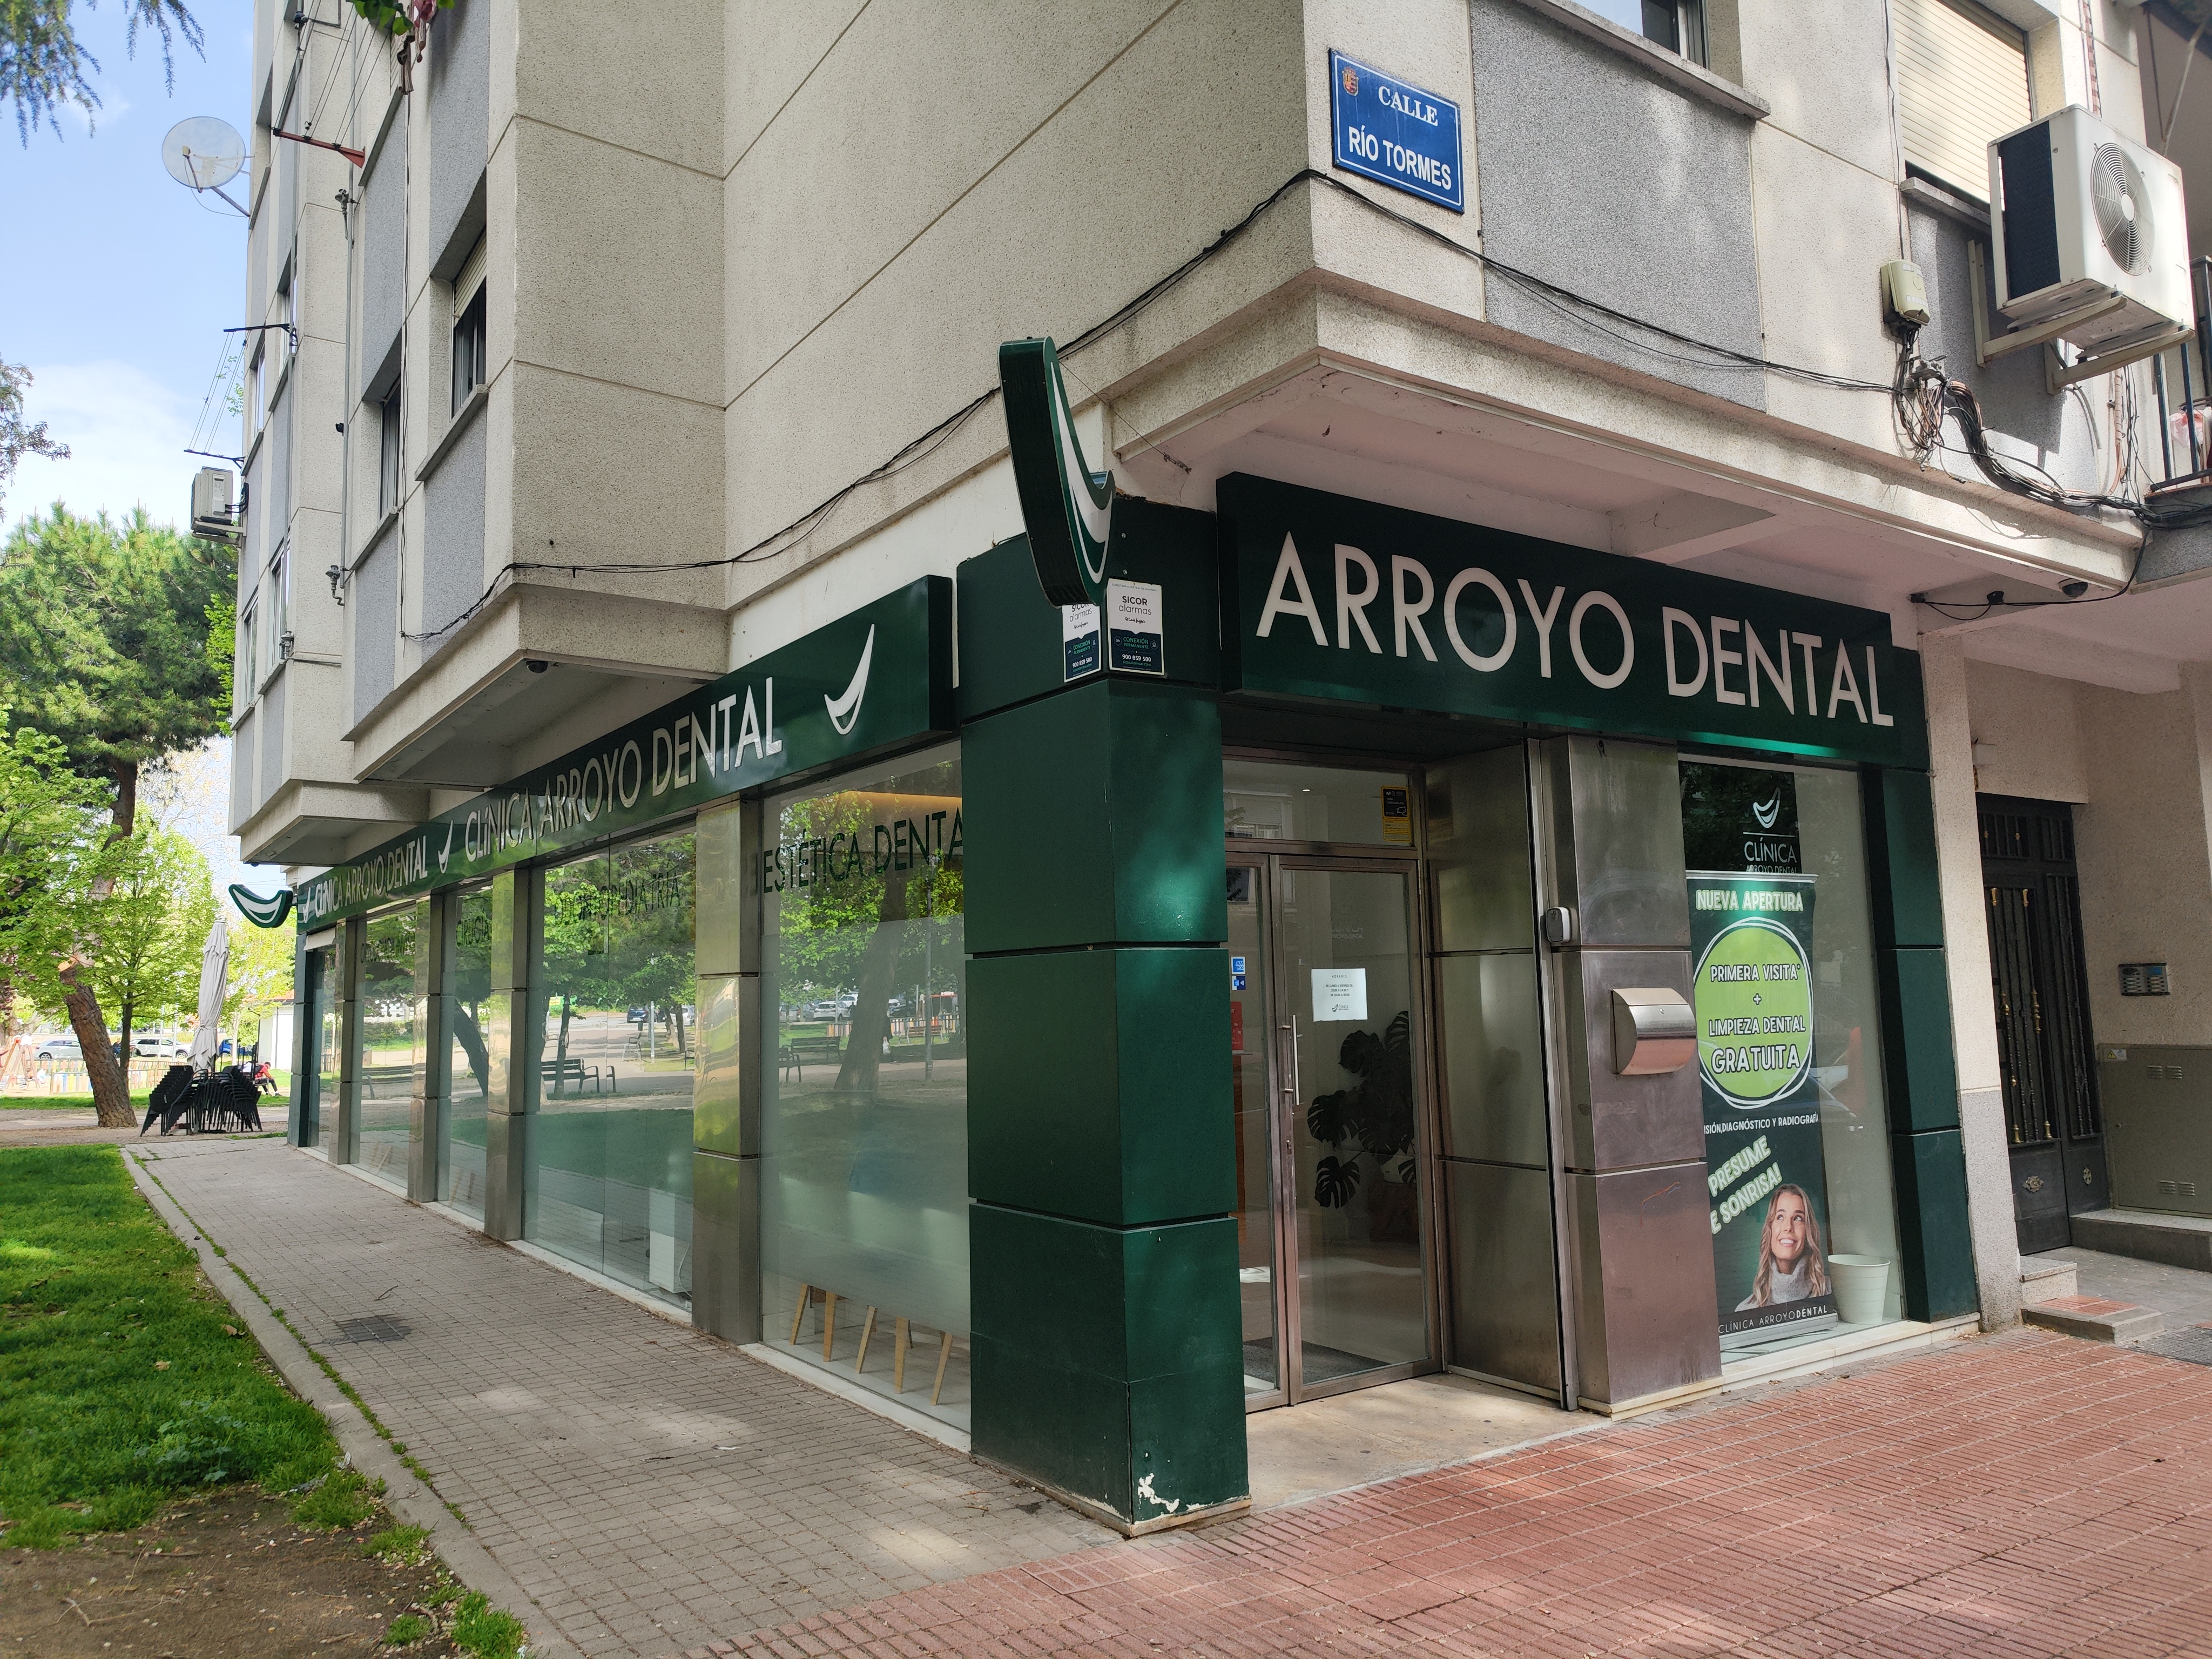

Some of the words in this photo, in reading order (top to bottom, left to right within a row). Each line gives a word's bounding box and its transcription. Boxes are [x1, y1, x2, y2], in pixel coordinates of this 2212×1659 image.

[1378, 86, 1438, 126] CALLE
[1348, 125, 1378, 161] RÍO
[1382, 139, 1452, 190] TORMES
[1118, 604, 1152, 615] alarmas
[1122, 596, 1148, 606] SICOR
[1069, 608, 1092, 622] alarmas
[1256, 531, 1635, 690] ARROYO
[1662, 605, 1894, 727] DENTAL
[1073, 639, 1090, 650] CONEXIÓN
[539, 740, 642, 838] ARROYO
[652, 677, 783, 797] DENTAL
[764, 828, 864, 893] ESTÉTICA
[1744, 837, 1797, 863] CLÍNICA
[345, 855, 384, 906] ARROYO
[387, 835, 428, 891] DENTAL
[1746, 865, 1773, 873] ARROYO
[1696, 889, 1739, 911] NUEVA
[1742, 891, 1804, 912] APERTURA
[1710, 964, 1760, 982] PRIMERA
[1709, 1017, 1761, 1037] LIMPIEZA
[1763, 1015, 1806, 1034] DENTAL
[1711, 1044, 1801, 1074] GRATUITA
[1772, 1117, 1777, 1128] Y
[1708, 1135, 1771, 1197] PRESUME
[1719, 1162, 1782, 1224] SONRISA!
[1718, 1321, 1754, 1333] CLÍNICA
